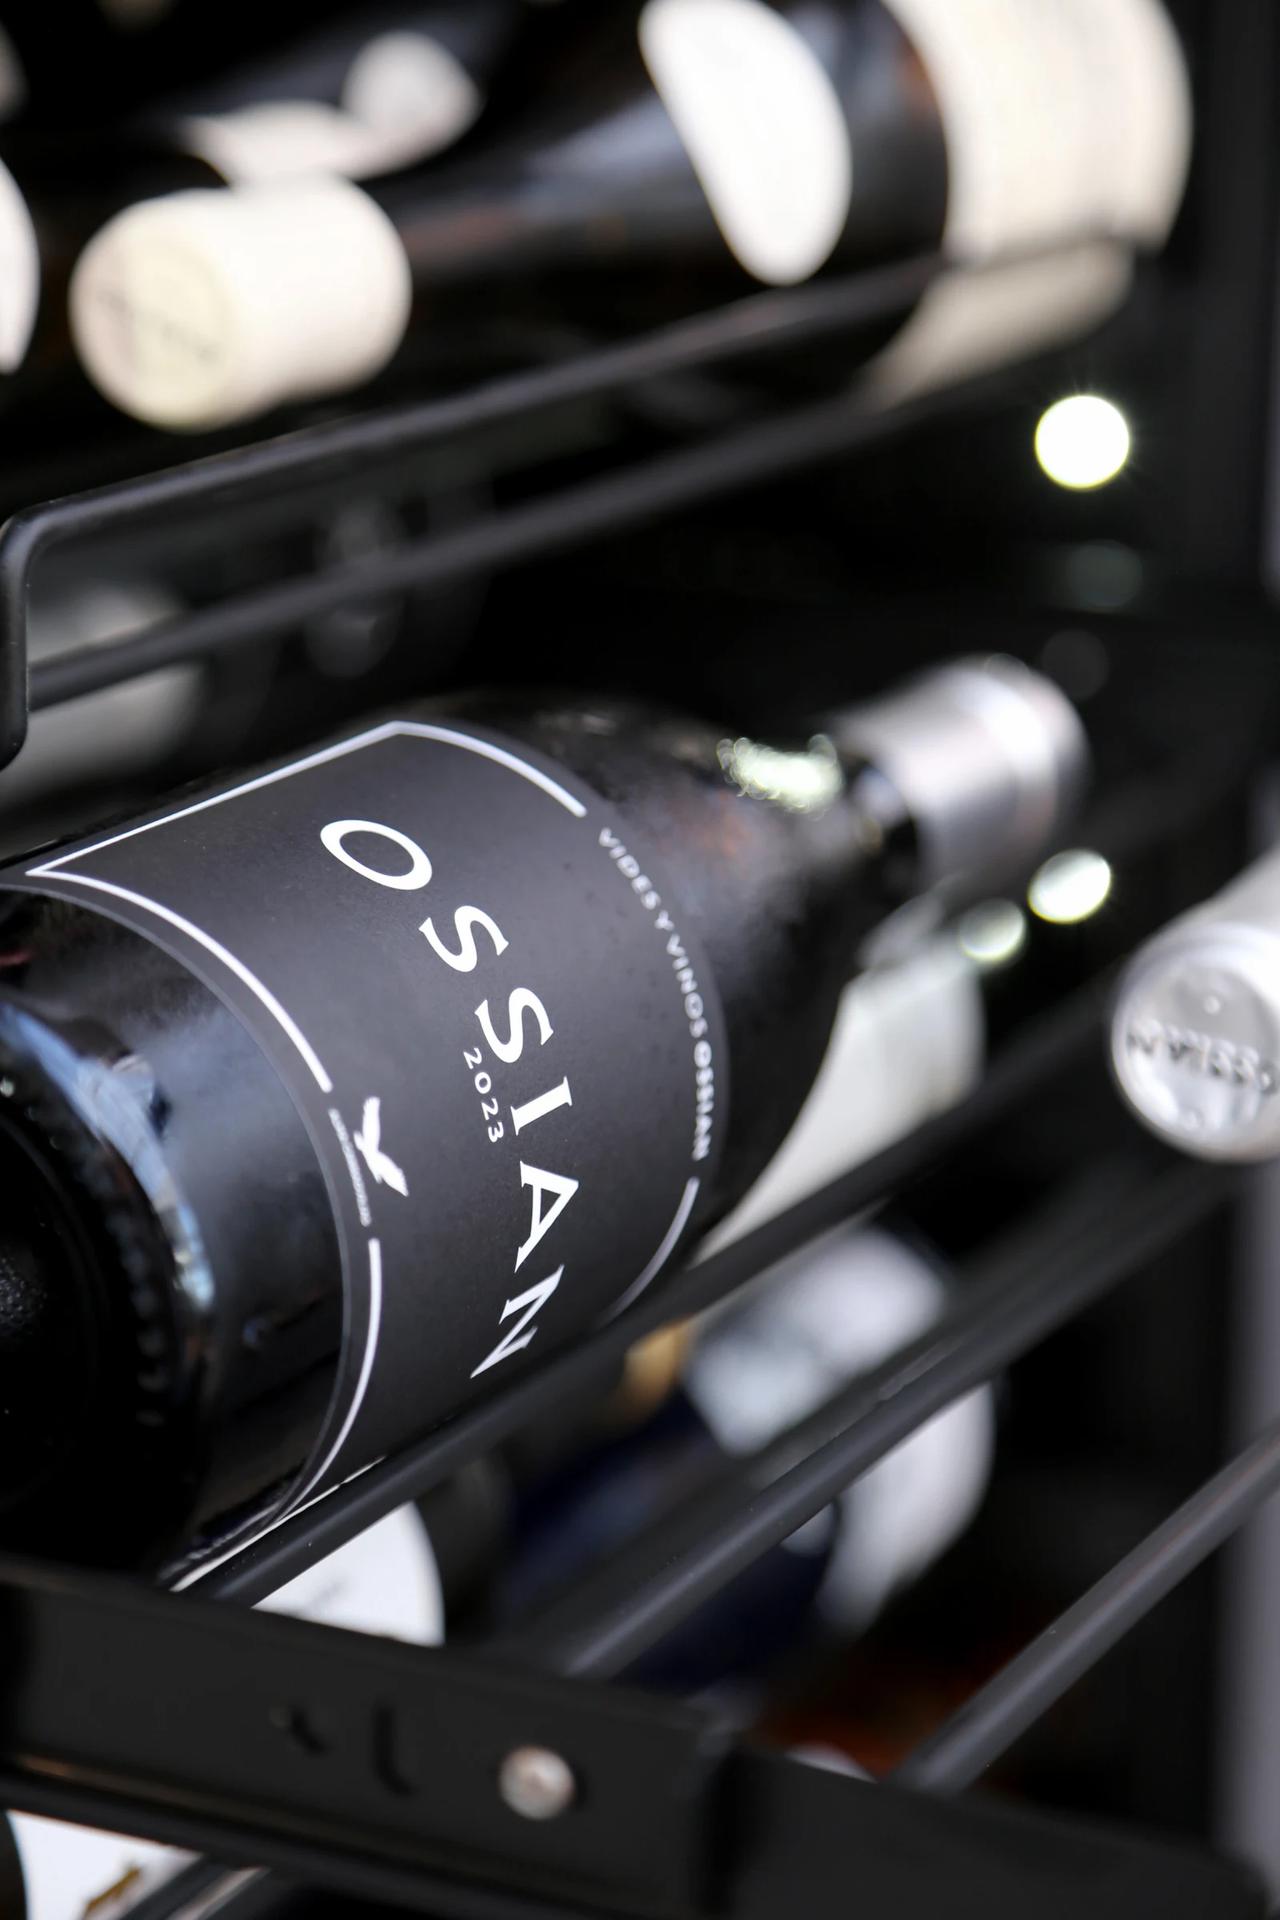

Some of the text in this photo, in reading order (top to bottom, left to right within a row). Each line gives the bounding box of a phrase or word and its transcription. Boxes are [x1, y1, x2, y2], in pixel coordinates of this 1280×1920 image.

[320, 820, 580, 1378] OSSIAN
[463, 1047, 504, 1142] 2023
[599, 827, 714, 1161] VIDES Y VINOS OSSIAN
